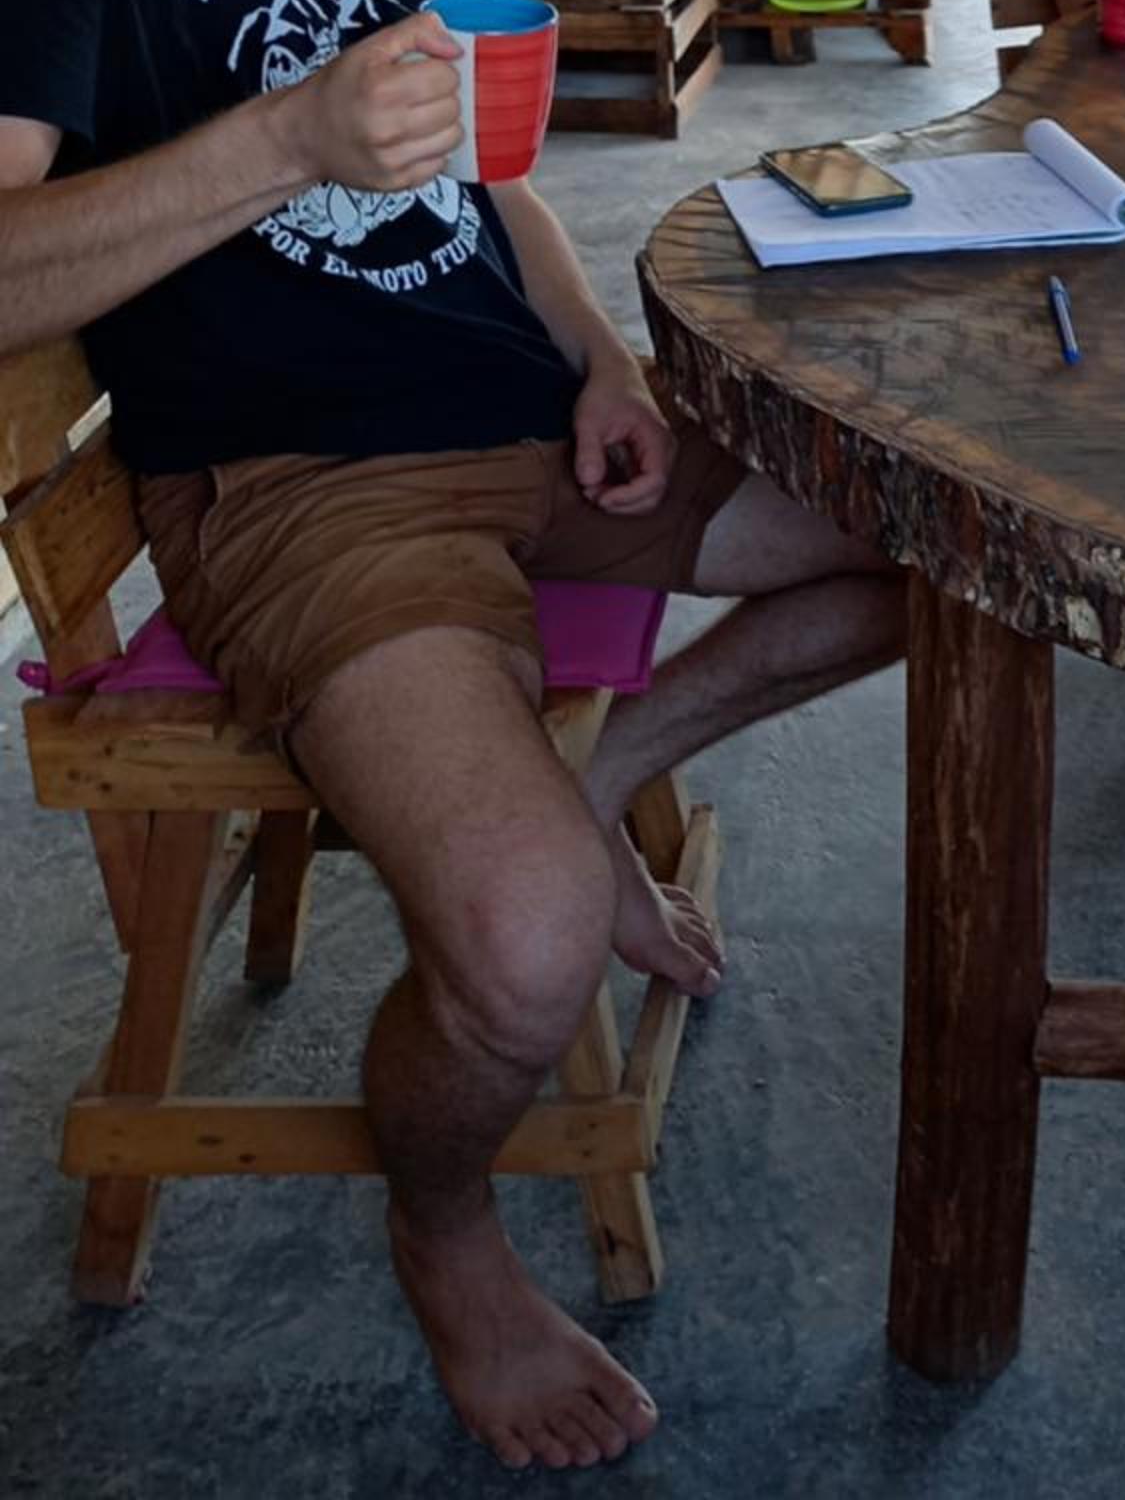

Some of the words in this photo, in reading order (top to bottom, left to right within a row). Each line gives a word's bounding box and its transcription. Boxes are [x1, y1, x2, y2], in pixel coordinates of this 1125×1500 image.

[253, 216, 312, 265] POR
[321, 252, 358, 279] EL
[360, 260, 428, 293] MOTO
